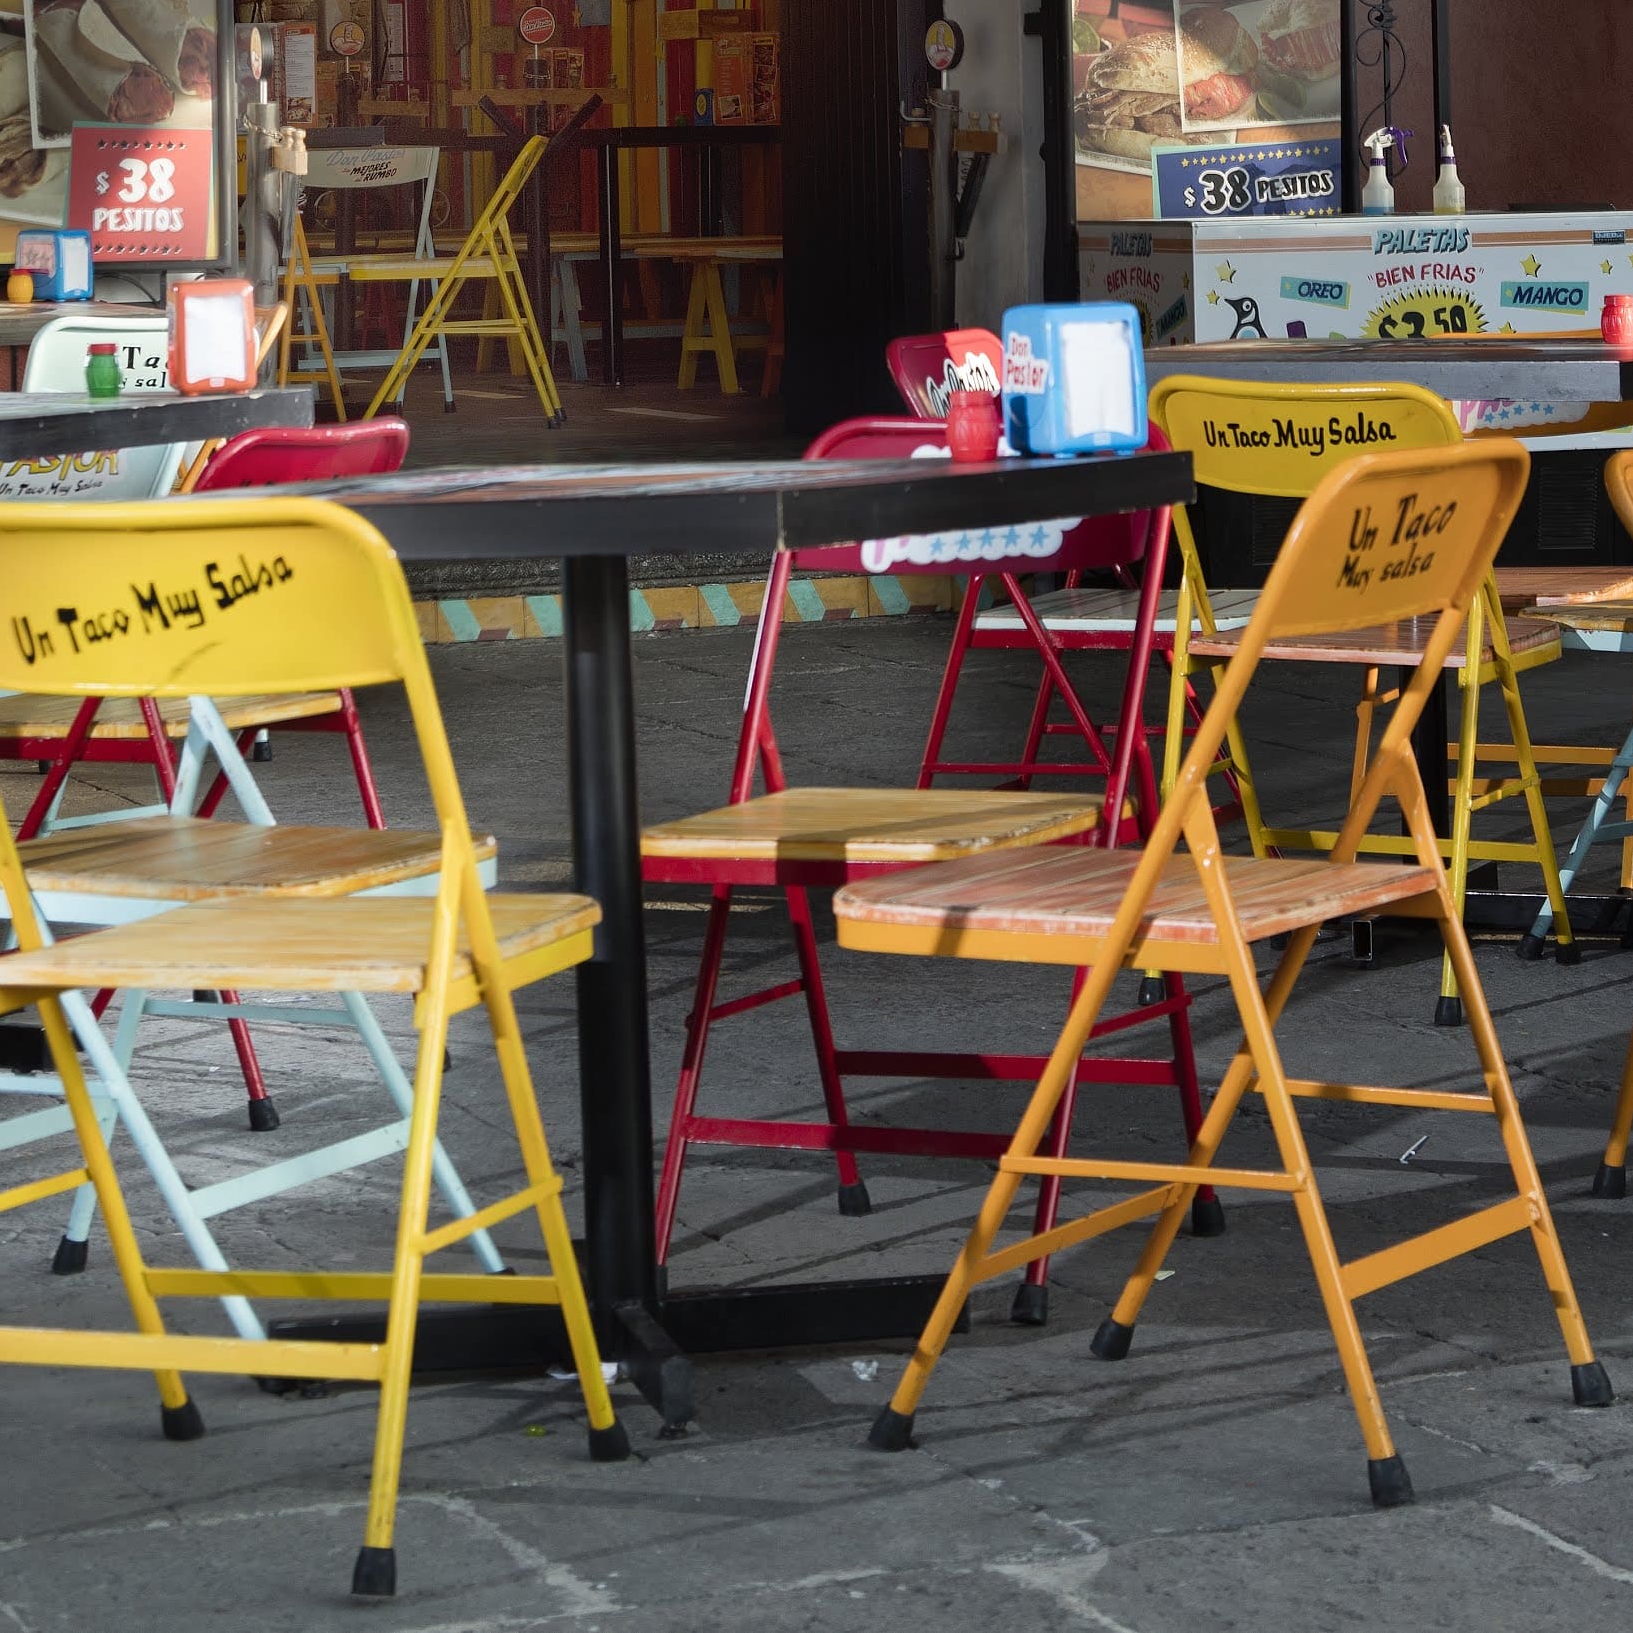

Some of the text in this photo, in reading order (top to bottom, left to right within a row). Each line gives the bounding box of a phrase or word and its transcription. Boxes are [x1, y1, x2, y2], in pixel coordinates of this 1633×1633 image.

[96, 157, 176, 203] $ 38
[350, 162, 391, 175] MEJORES
[363, 168, 398, 182] RUMBO
[1183, 167, 1335, 214] $ 38 PESITOS
[92, 207, 185, 232] PESITOS
[1110, 231, 1153, 257] PALETAS
[1374, 227, 1471, 255] PALETAS
[1298, 281, 1344, 300] OREO
[1513, 286, 1585, 306] MANGO
[123, 346, 168, 370] Ta
[1009, 337, 1029, 355] Don
[135, 371, 167, 388] sal
[1007, 358, 1046, 388] Pastor
[1204, 412, 1396, 456] Un Taco Muy Salsa
[17, 483, 45, 496] Taco
[46, 482, 71, 497] Muy
[74, 479, 104, 493] Salsa
[1348, 492, 1457, 551] Un Taco
[1337, 541, 1435, 595] Muy salsa
[11, 552, 294, 666] Un Taco Muy Salsa
